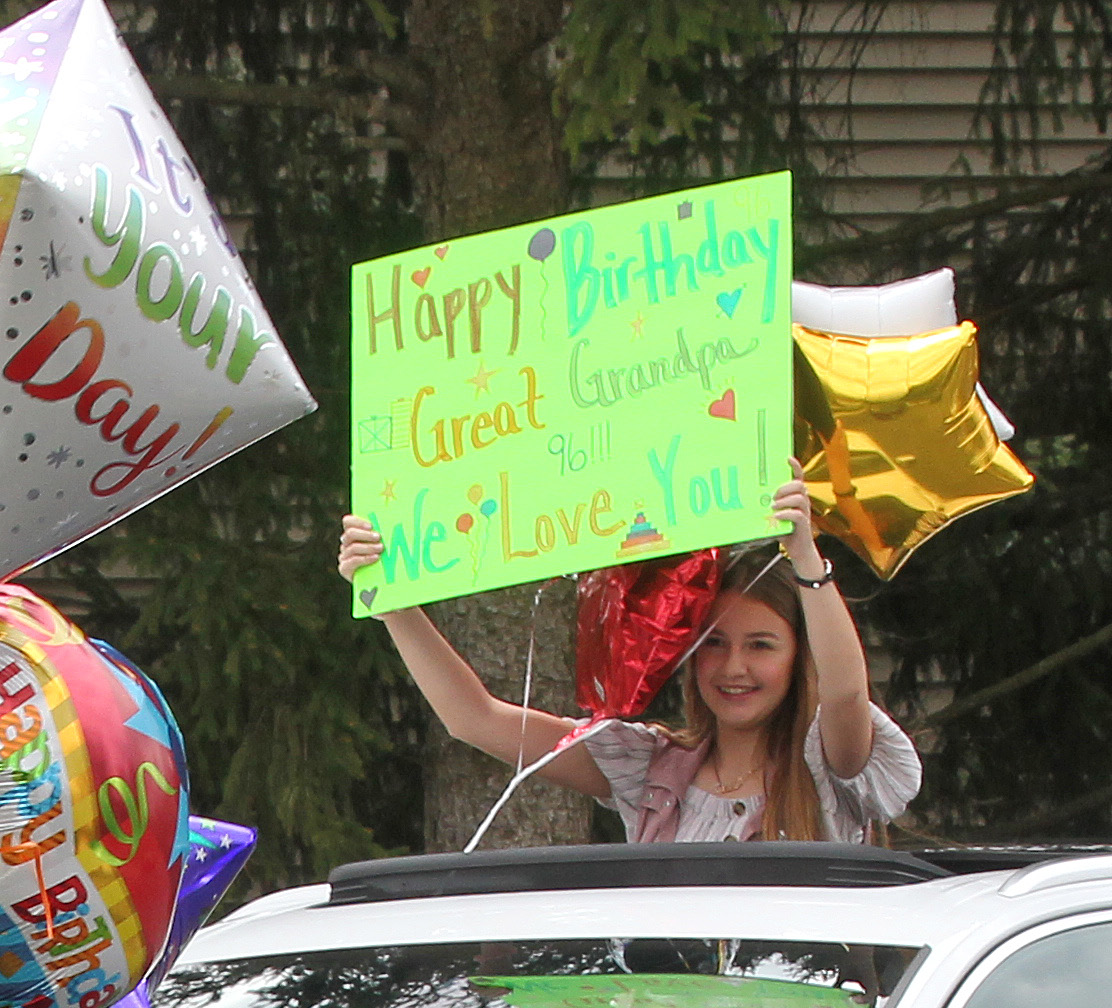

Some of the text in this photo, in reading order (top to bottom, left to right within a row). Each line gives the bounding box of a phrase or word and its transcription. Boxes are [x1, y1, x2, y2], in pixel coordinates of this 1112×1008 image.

[366, 199, 780, 360] Happy Birthday
[3, 301, 234, 497] Day!
[410, 328, 760, 468] Great Grandpa
[370, 488, 460, 584] We
[500, 472, 626, 562] Love
